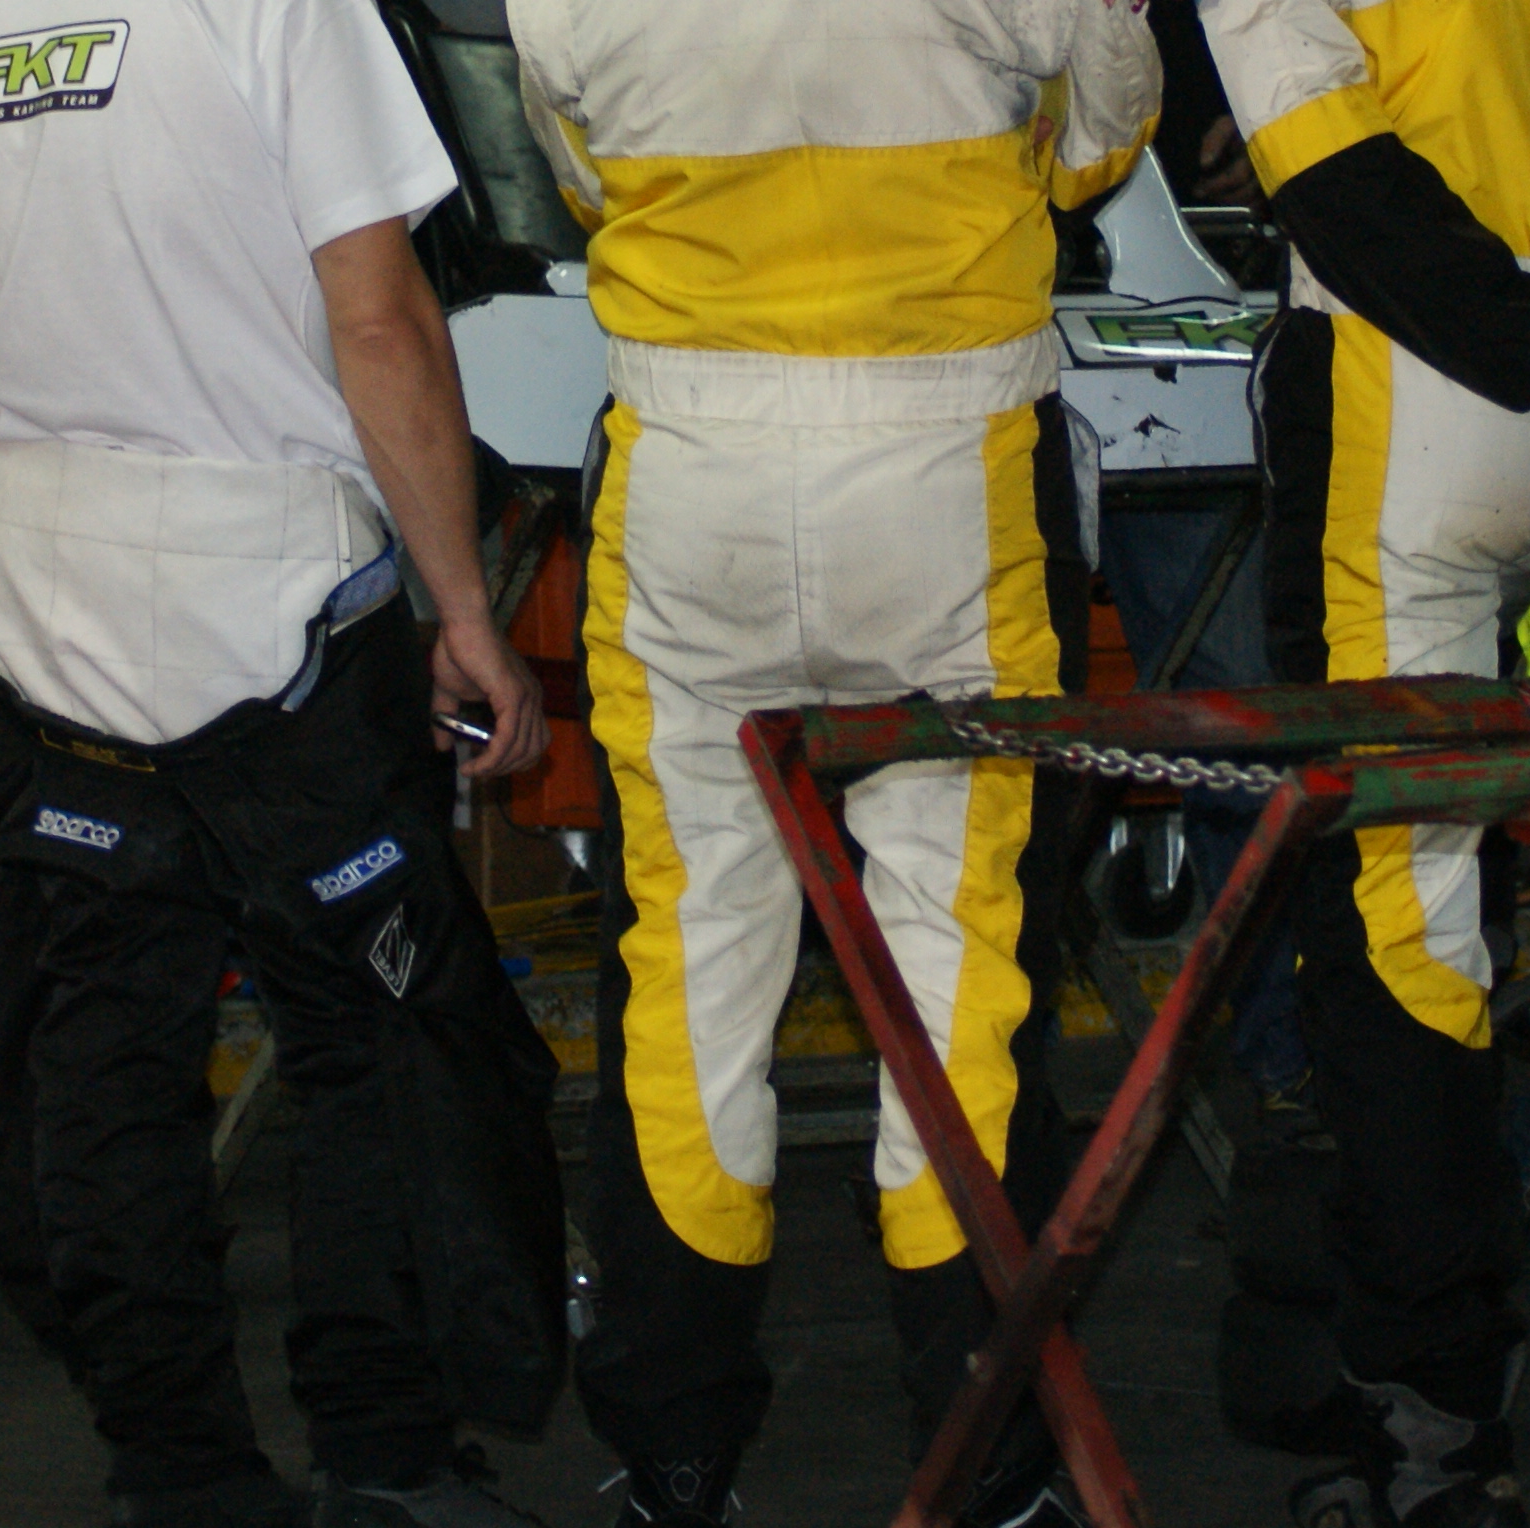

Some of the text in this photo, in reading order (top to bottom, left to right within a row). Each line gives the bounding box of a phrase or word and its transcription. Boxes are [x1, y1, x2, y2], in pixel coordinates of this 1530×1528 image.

[62, 94, 99, 107] TEAM
[35, 808, 120, 848] sparco
[311, 840, 400, 900] sparco
